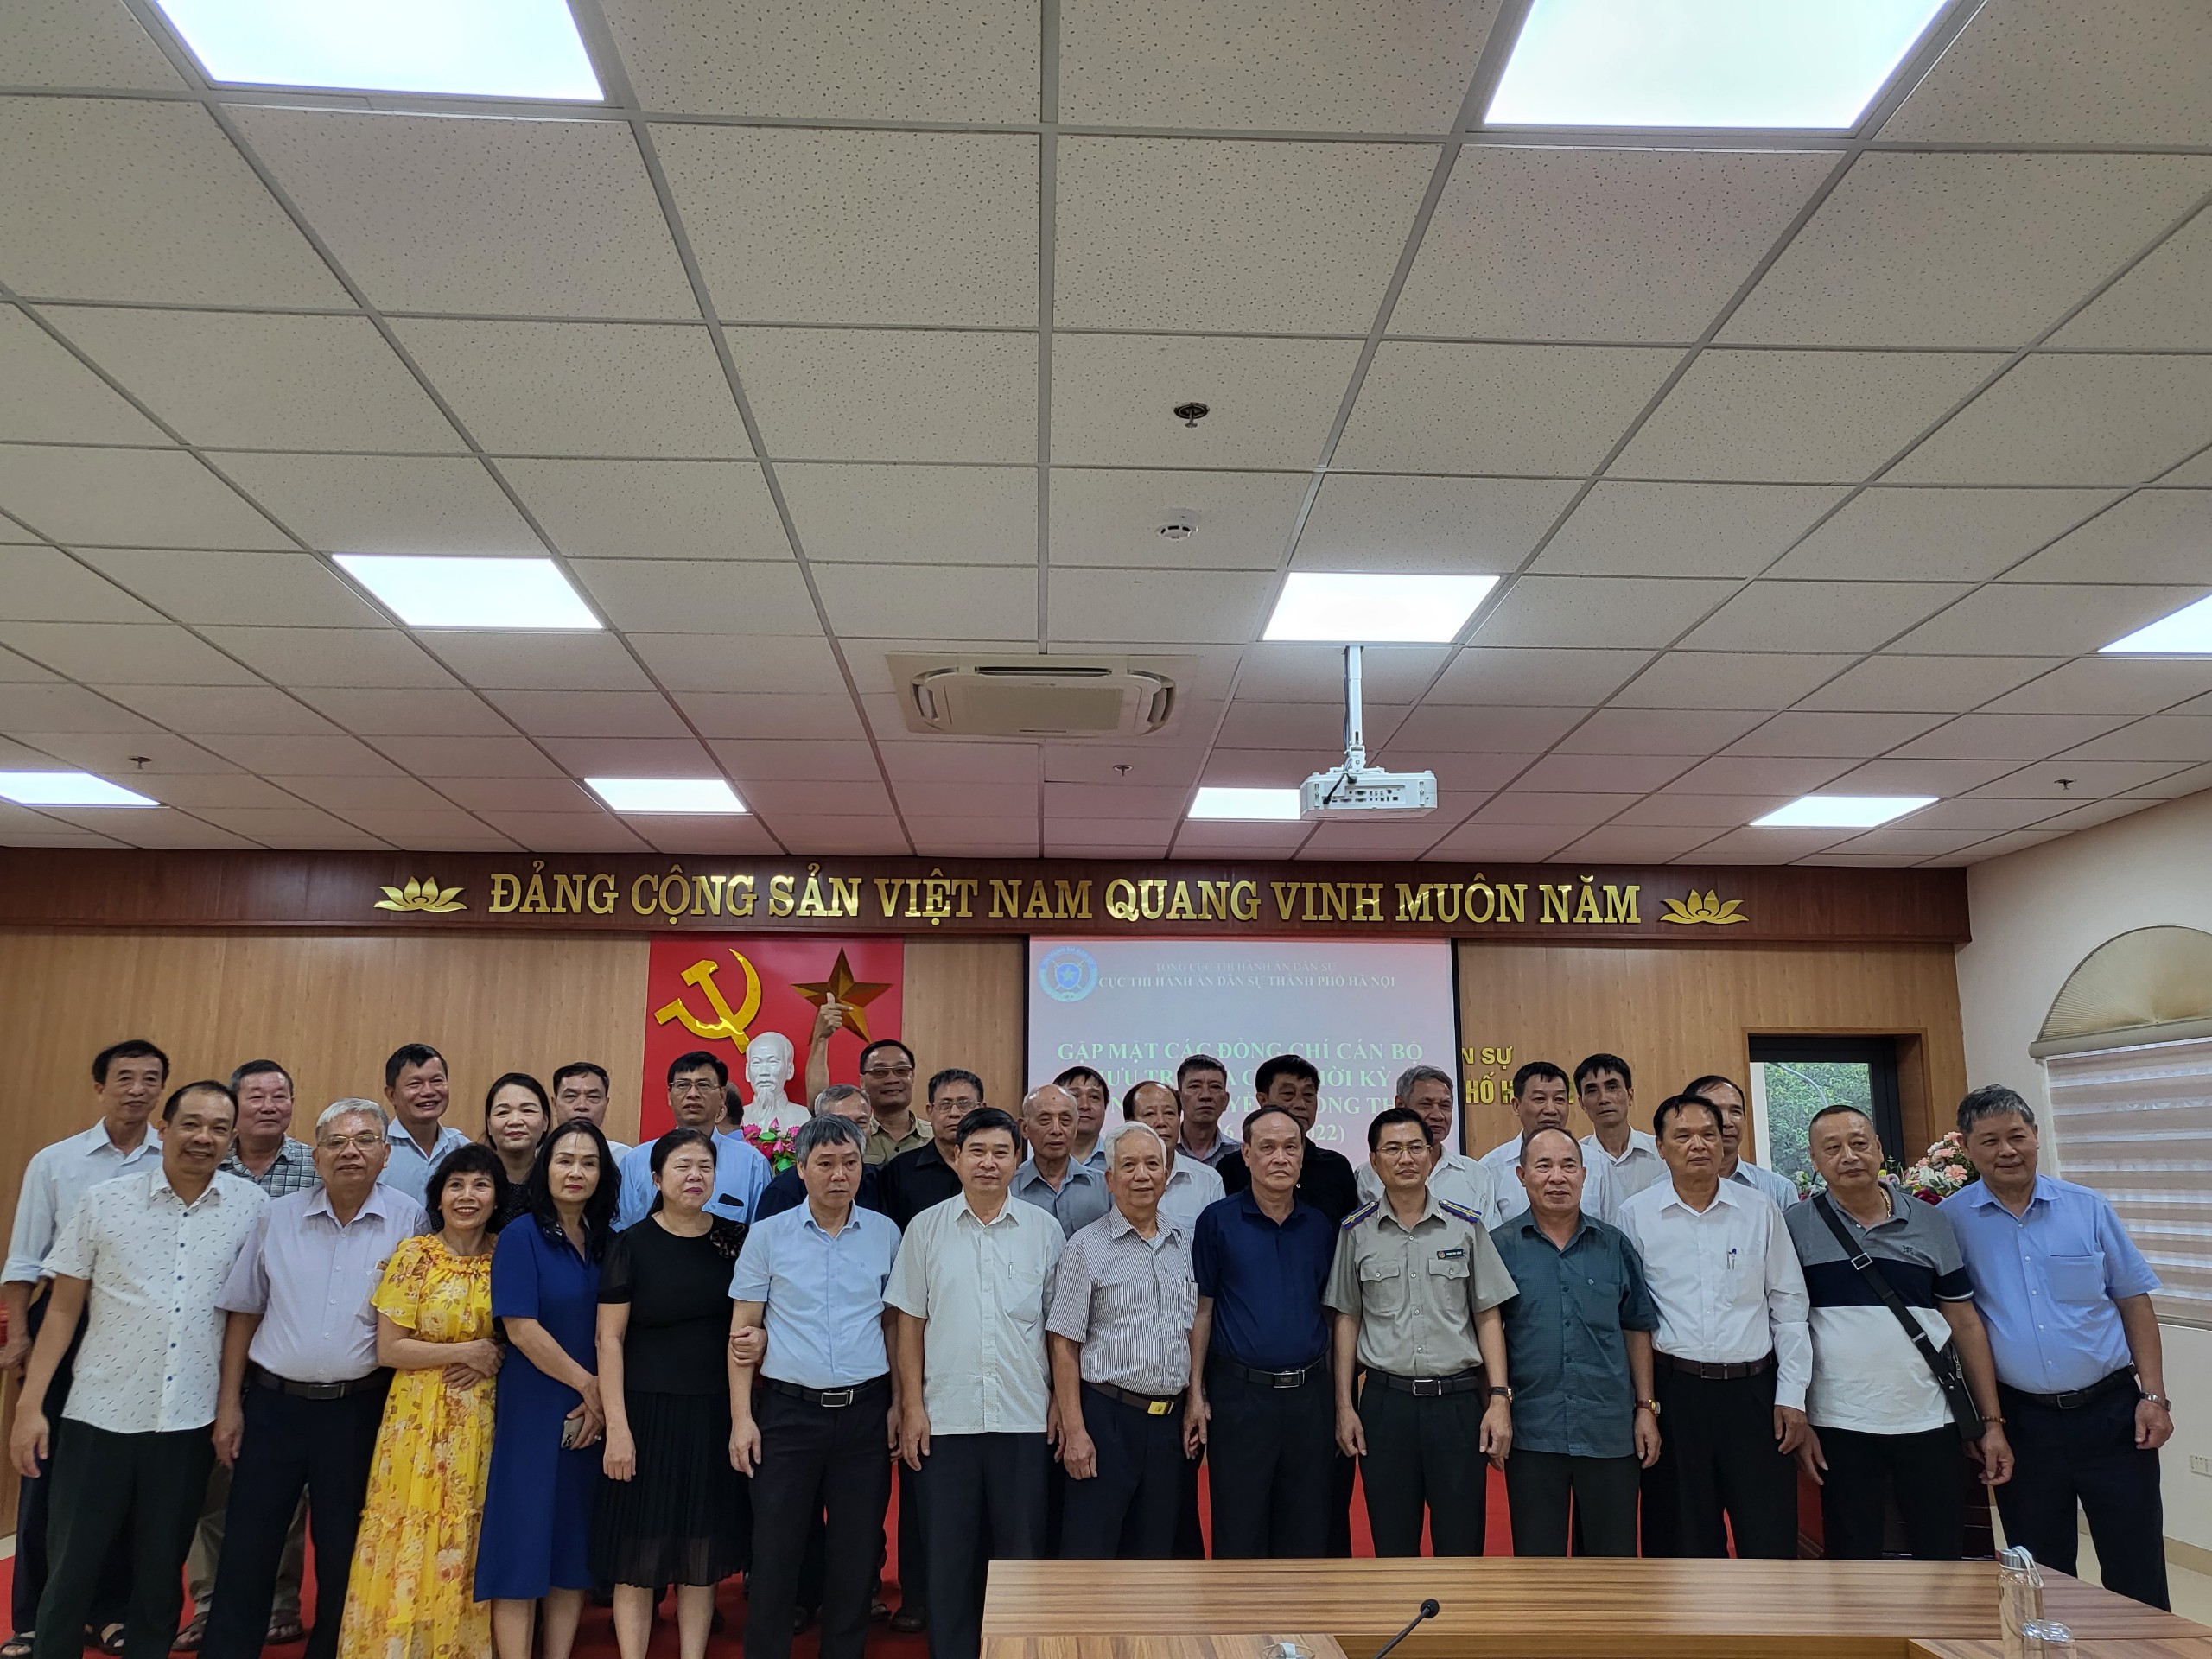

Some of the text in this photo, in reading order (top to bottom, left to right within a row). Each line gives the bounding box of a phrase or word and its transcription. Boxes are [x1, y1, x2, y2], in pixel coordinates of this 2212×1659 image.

[488, 860, 1641, 925] ĐẢNG CỘNG SẢN VIỆT NAM QUANG VINH MUÔN NĂM
[1098, 976, 1126, 989] CỤC
[1129, 976, 1152, 988] THI
[1155, 974, 1192, 988] HÀNH
[1217, 973, 1244, 988] DÂN
[1268, 974, 1313, 988] THÀNH
[1349, 974, 1368, 987] HÀ
[1058, 1040, 1103, 1065] GẶP
[1109, 1040, 1159, 1064] MẶT
[1336, 1039, 1383, 1060] CÁN
[1392, 1041, 1423, 1065] BỘ
[1481, 1046, 1513, 1070] SỰ
[1360, 1065, 1391, 1087] KỲ
[1465, 1071, 1495, 1103] HỐ
